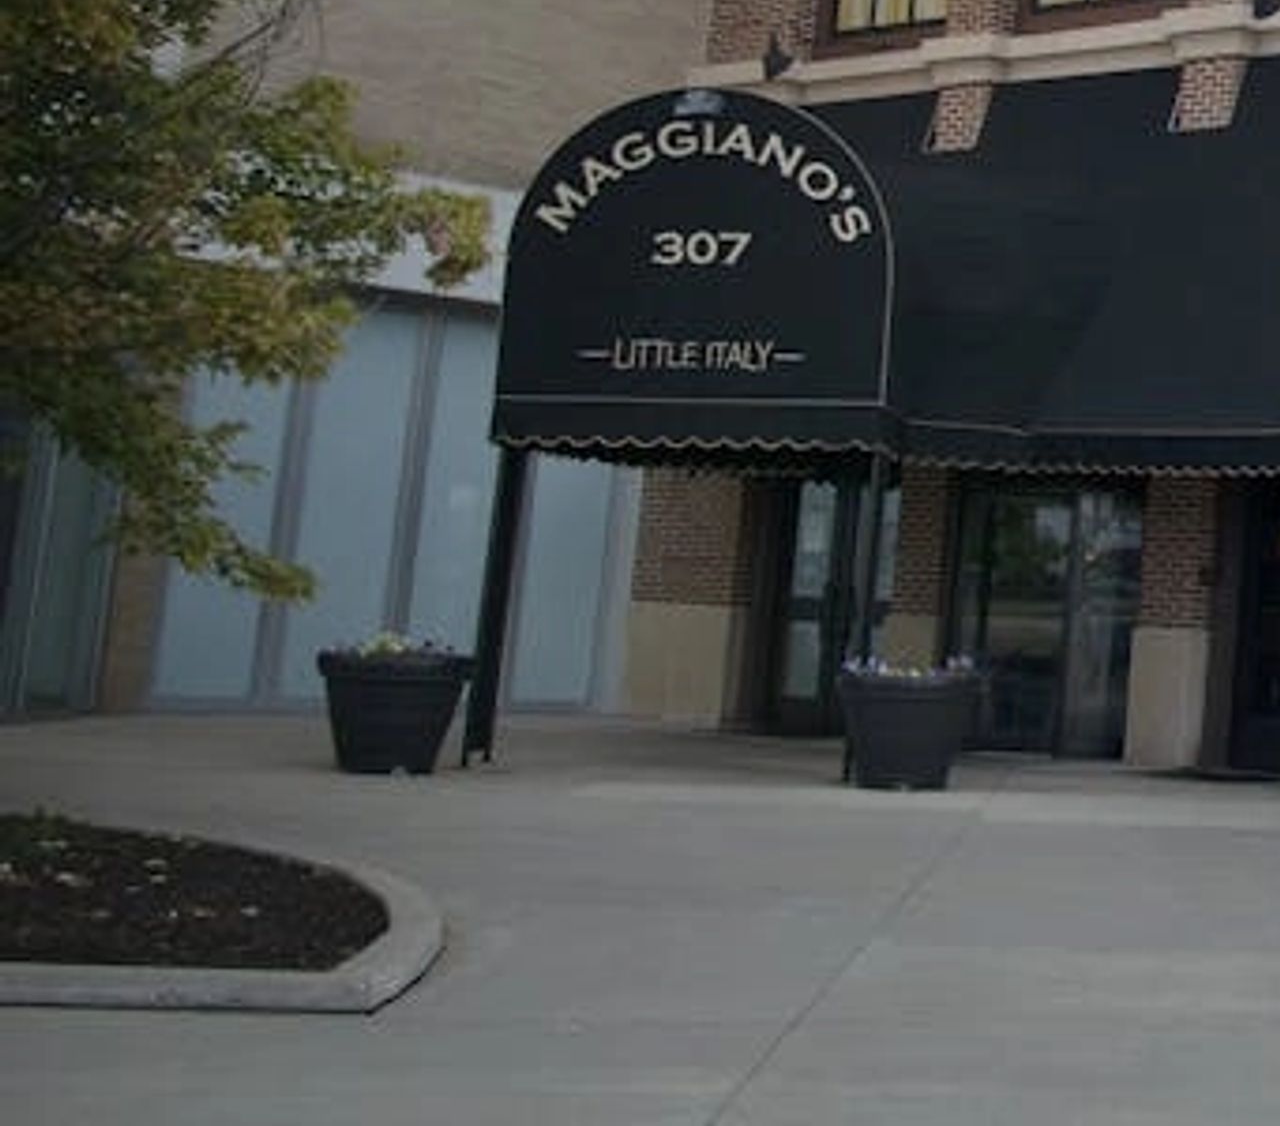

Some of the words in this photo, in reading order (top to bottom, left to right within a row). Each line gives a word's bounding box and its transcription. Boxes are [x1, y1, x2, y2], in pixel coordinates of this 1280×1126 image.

[536, 119, 872, 243] MAGGIANO'S
[651, 231, 752, 266] 307
[613, 337, 699, 370] LITTLE
[704, 340, 776, 372] ITALY
